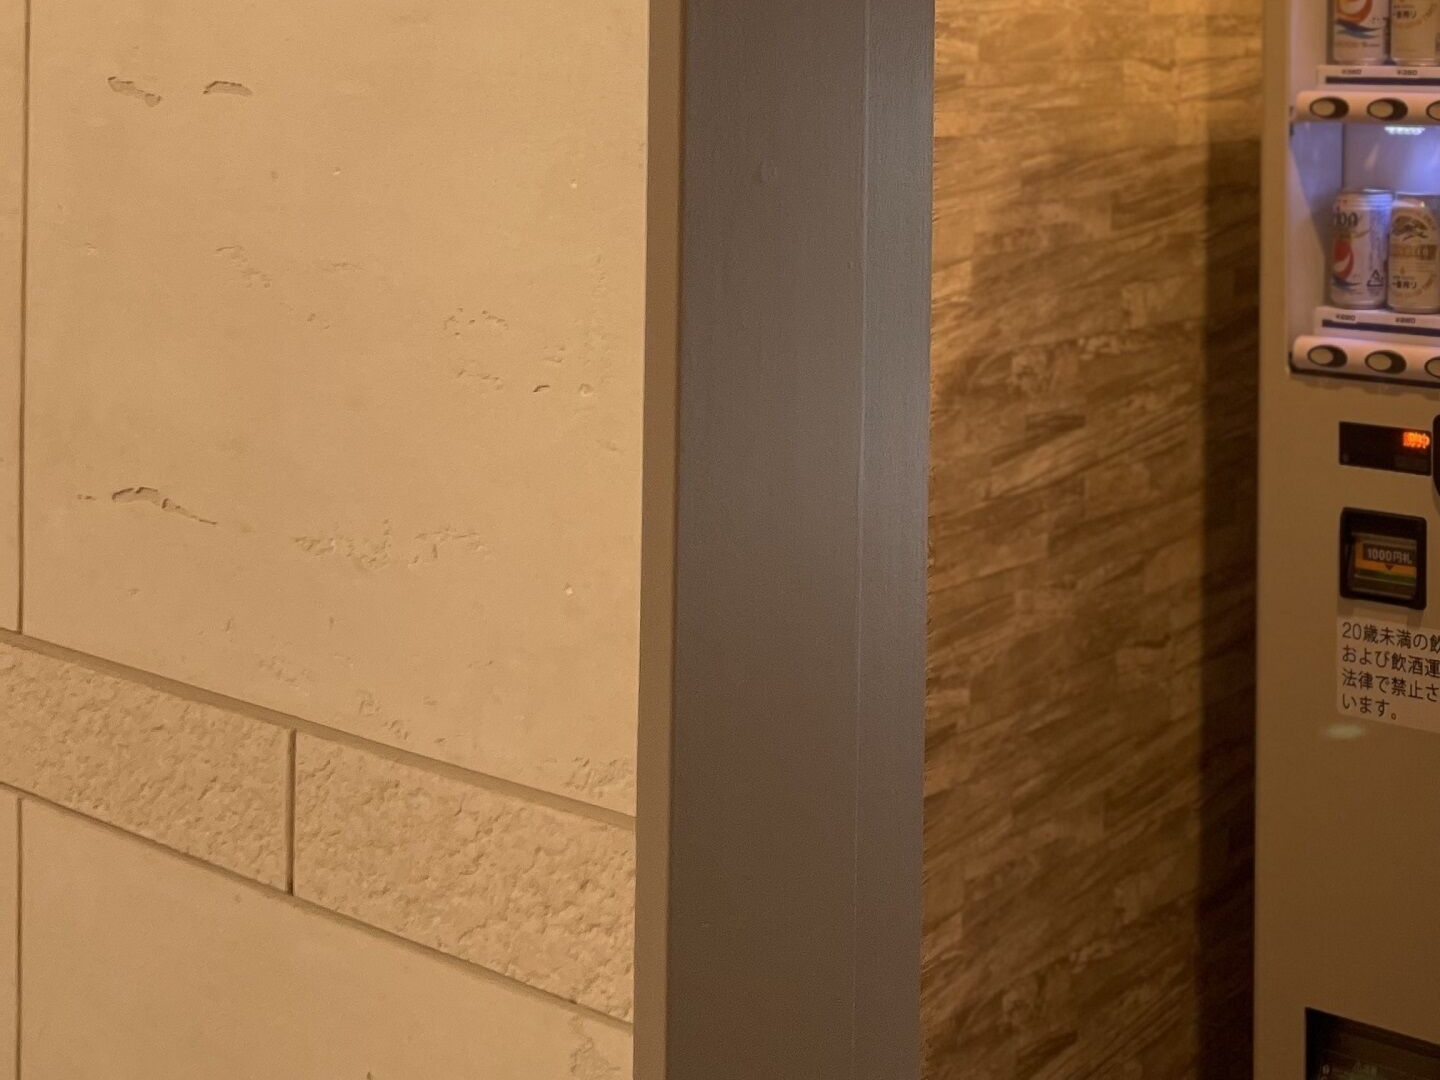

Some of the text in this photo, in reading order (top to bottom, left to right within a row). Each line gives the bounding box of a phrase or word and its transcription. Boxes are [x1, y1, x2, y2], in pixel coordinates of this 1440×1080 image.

[1367, 547, 1413, 565] 1000円札
[1342, 694, 1398, 720] います。
